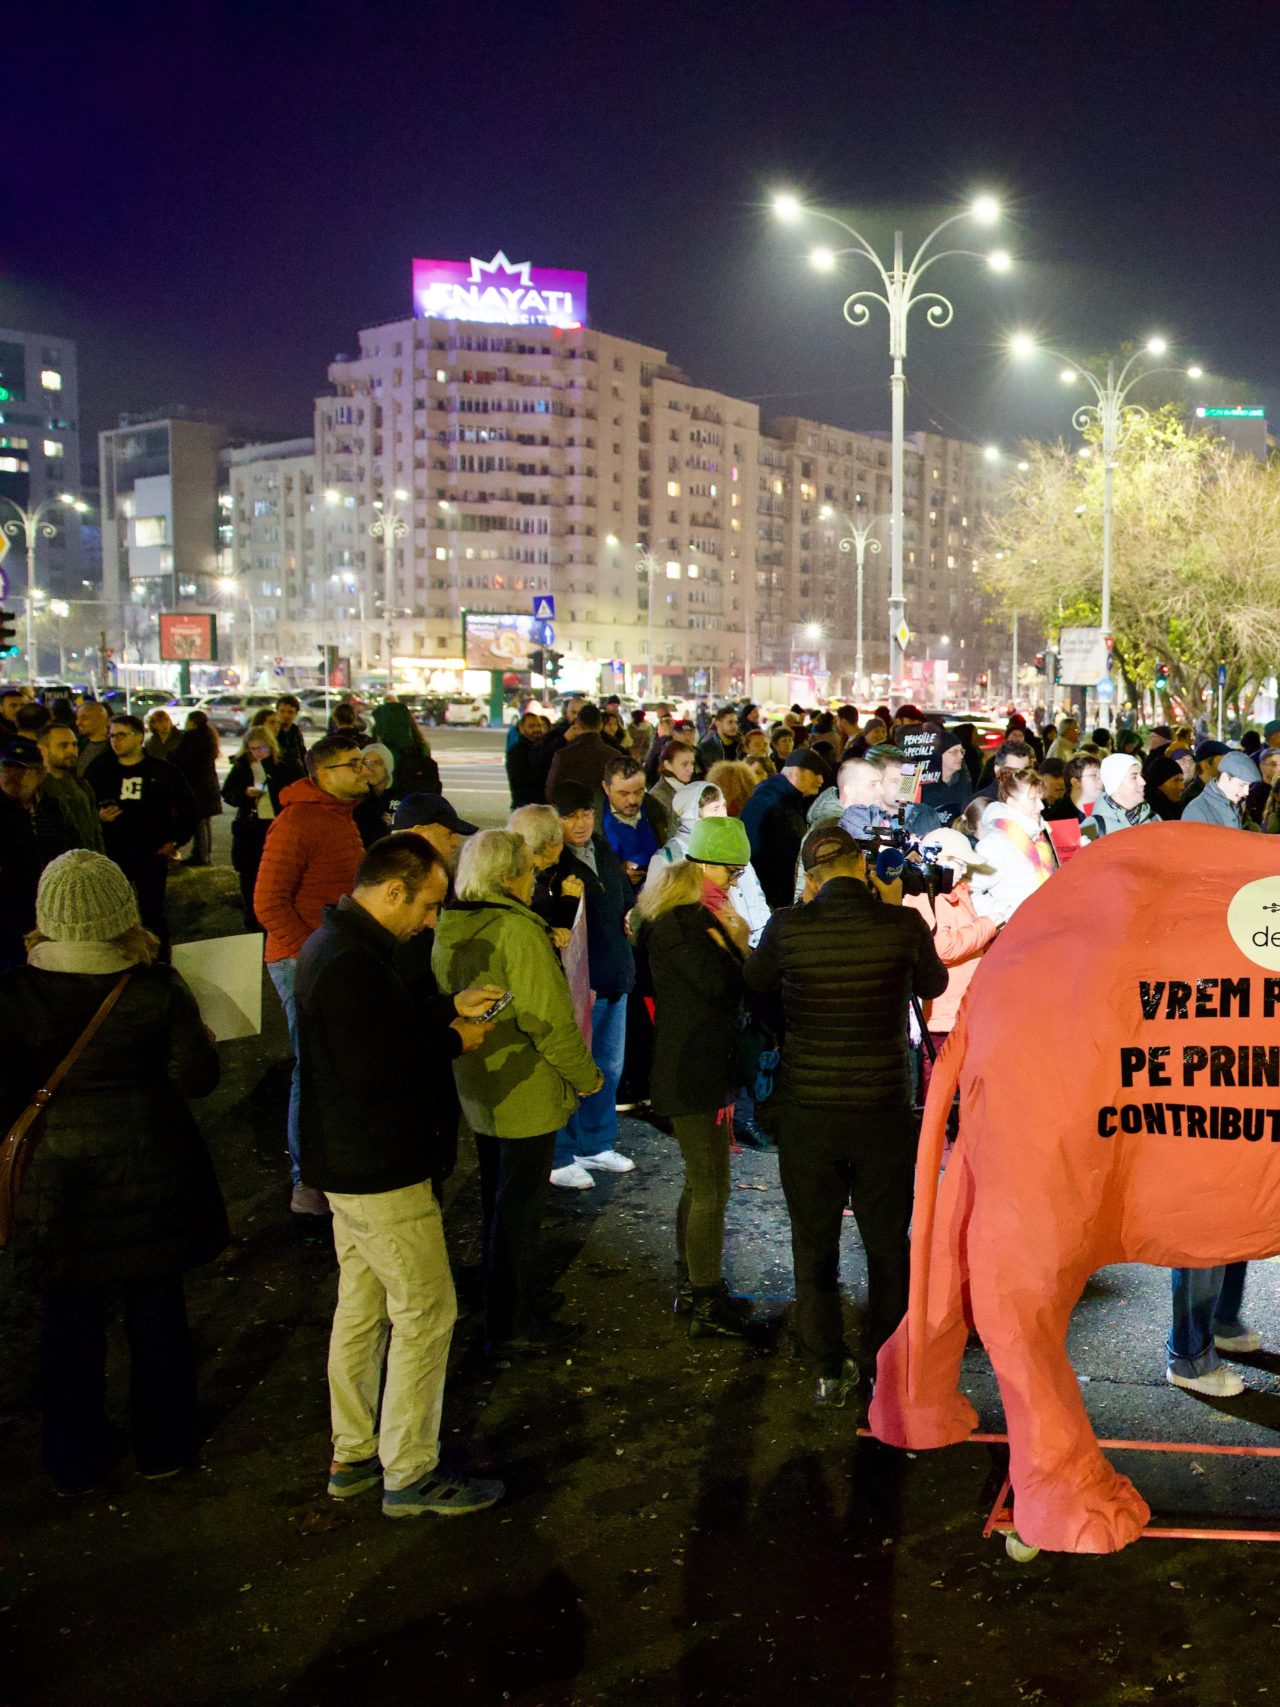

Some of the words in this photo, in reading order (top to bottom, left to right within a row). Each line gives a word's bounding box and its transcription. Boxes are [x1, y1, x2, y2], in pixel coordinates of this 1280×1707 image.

[429, 282, 573, 314] ENAYATI
[1138, 977, 1251, 1021] VREM
[1120, 1046, 1172, 1088] PE
